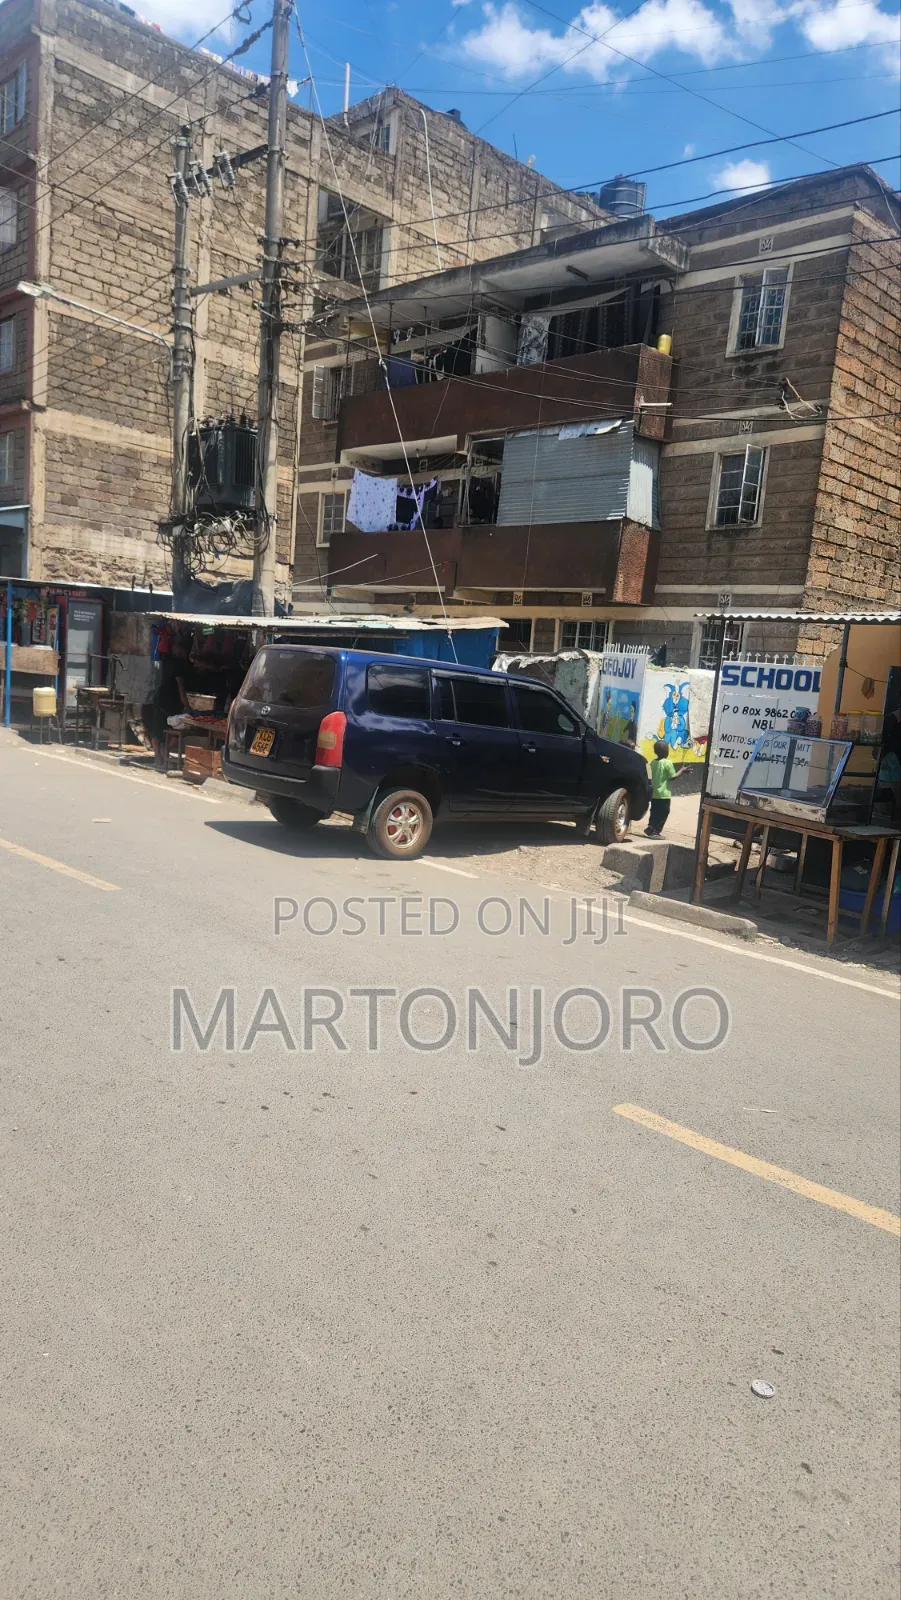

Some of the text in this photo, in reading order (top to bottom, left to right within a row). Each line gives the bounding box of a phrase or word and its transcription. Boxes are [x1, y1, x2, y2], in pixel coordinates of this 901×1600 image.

[722, 704, 730, 713] P
[742, 706, 761, 717] BOX
[751, 719, 774, 730] NBL
[746, 737, 757, 746] SK
[773, 740, 787, 750] OUR
[718, 747, 739, 760] TEL:
